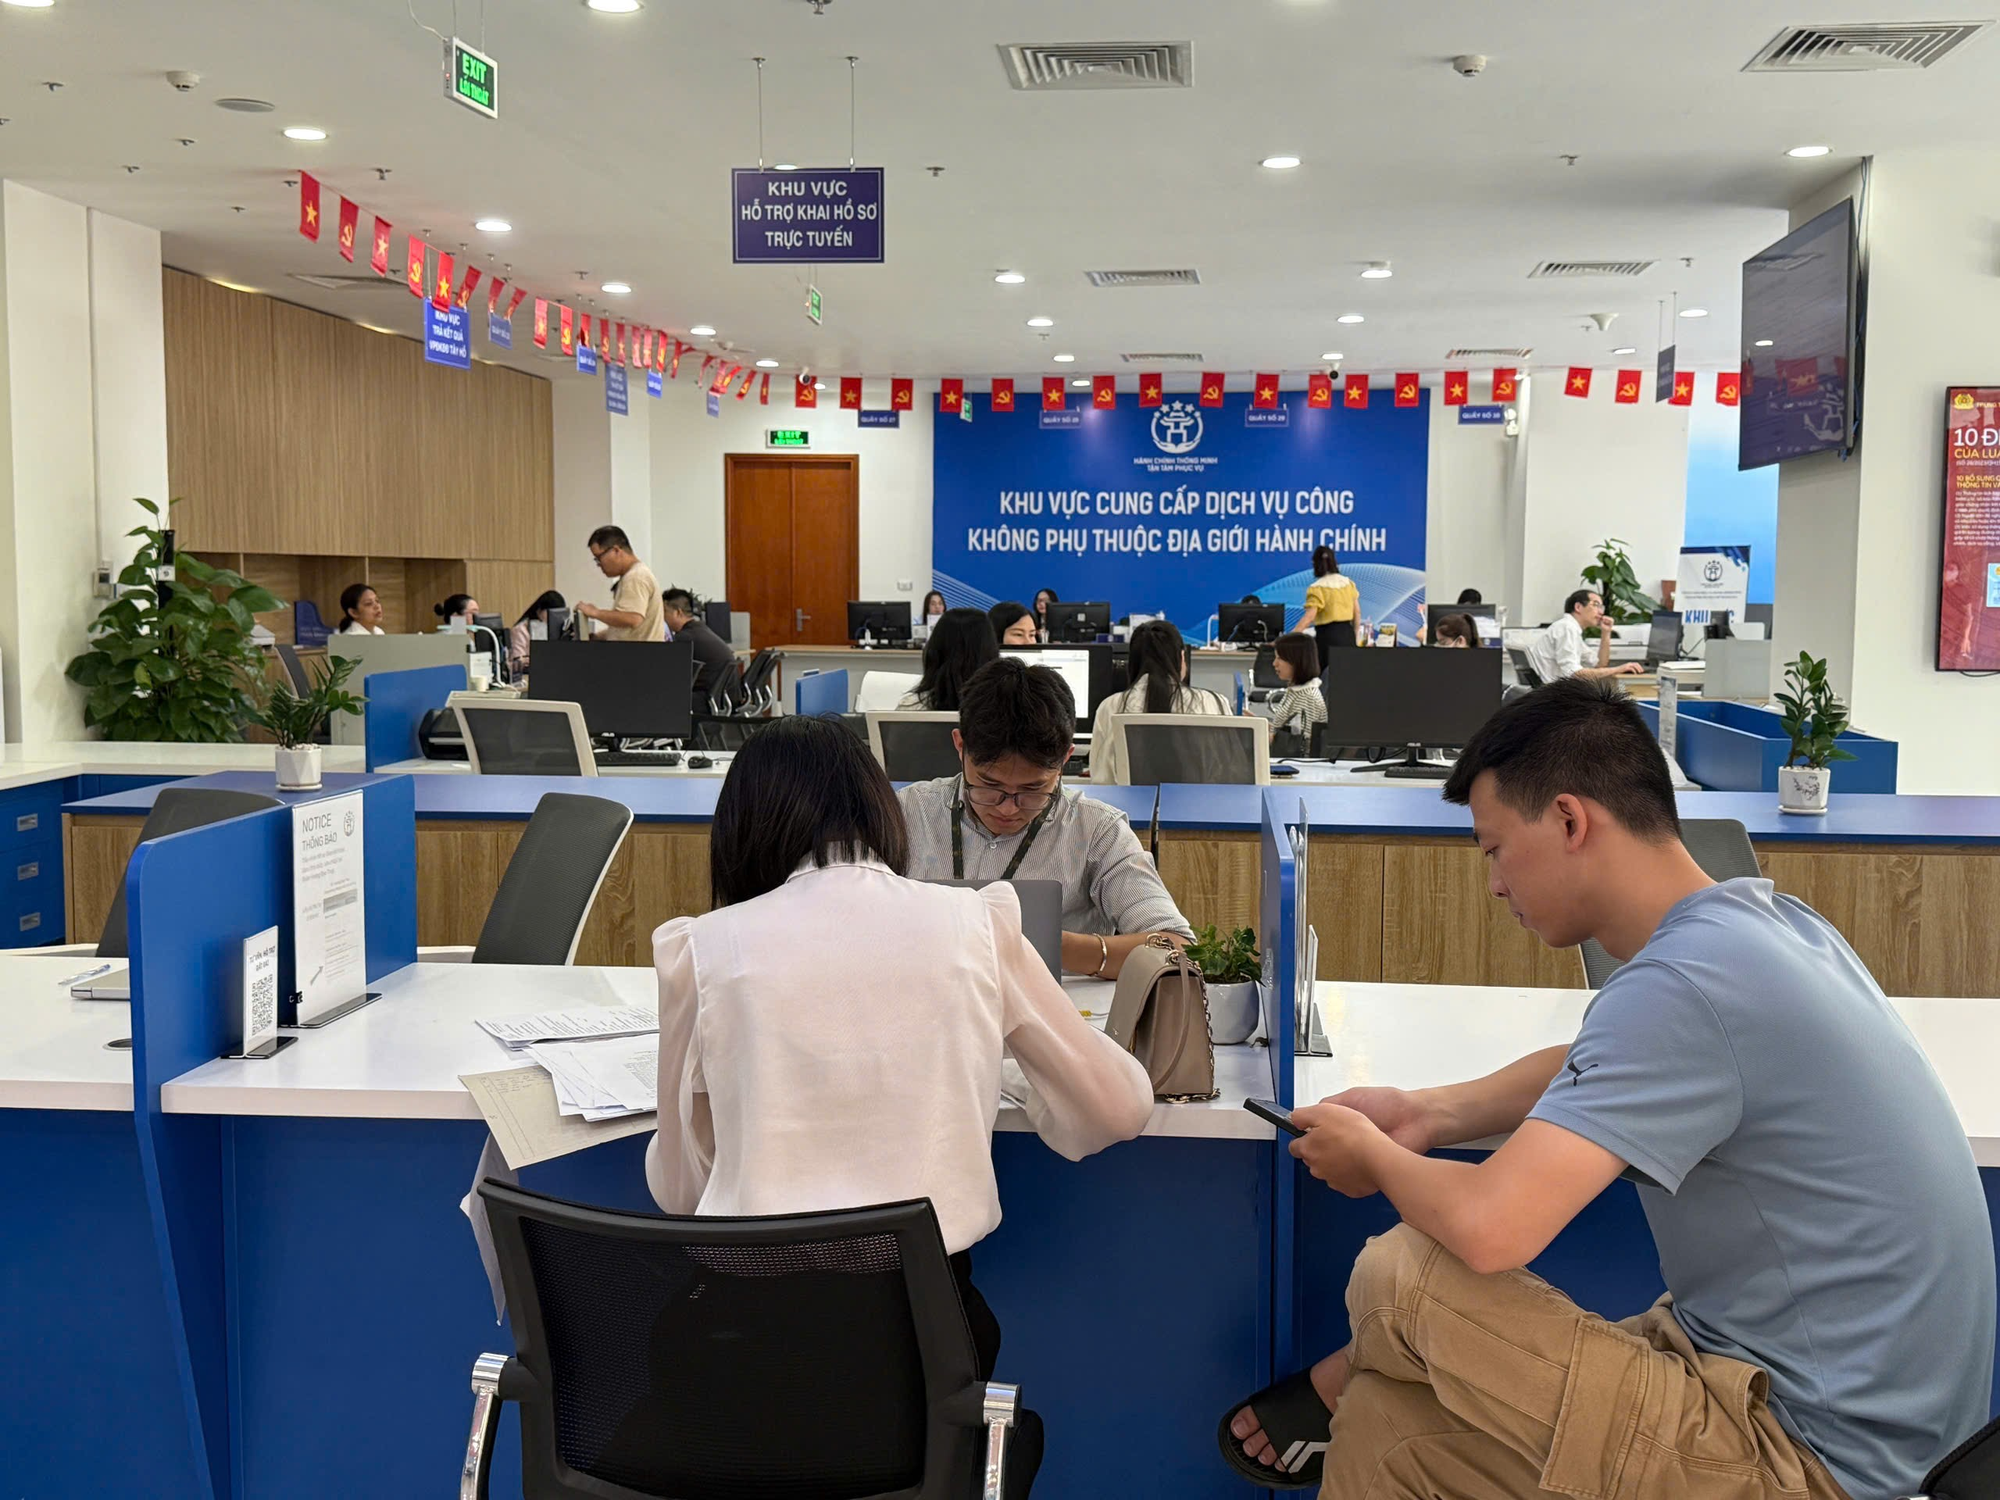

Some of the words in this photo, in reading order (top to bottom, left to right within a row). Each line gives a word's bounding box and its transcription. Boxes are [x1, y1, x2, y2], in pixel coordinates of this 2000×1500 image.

[462, 52, 487, 83] EXIT
[768, 181, 805, 196] KHU
[810, 179, 848, 198] VỰC
[741, 198, 761, 220] HỖ
[765, 202, 794, 223] TRỢ
[797, 204, 830, 220] KHAI
[834, 198, 854, 220] HỒ
[857, 202, 877, 220] SƠ
[765, 229, 803, 249] TRỰC
[806, 225, 853, 247] TUYẾN
[1953, 428, 1979, 446] 10
[1133, 456, 1153, 464] HÀNH
[1154, 456, 1175, 464] CHÍNH
[1954, 446, 1979, 459] CỦA
[1000, 491, 1043, 515] KHU
[1048, 490, 1090, 520] VỰC
[1096, 491, 1153, 515] CUNG
[1159, 484, 1200, 515] CẤP
[1205, 491, 1255, 520] DỊCH
[1261, 491, 1289, 520] VỤ
[1295, 486, 1354, 515] CÔNG
[968, 524, 1040, 552] KHÔNG
[1046, 528, 1087, 558] PHỤ
[1092, 524, 1162, 558] THUỘC
[1167, 528, 1202, 558] ĐỊA
[1207, 524, 1249, 552] GIỚI
[1256, 524, 1314, 552] HÀNH
[1320, 523, 1386, 552] CHÍNH
[302, 813, 332, 834] NOTICE
[302, 834, 324, 851] THÔNG
[325, 831, 338, 845] BÁO
